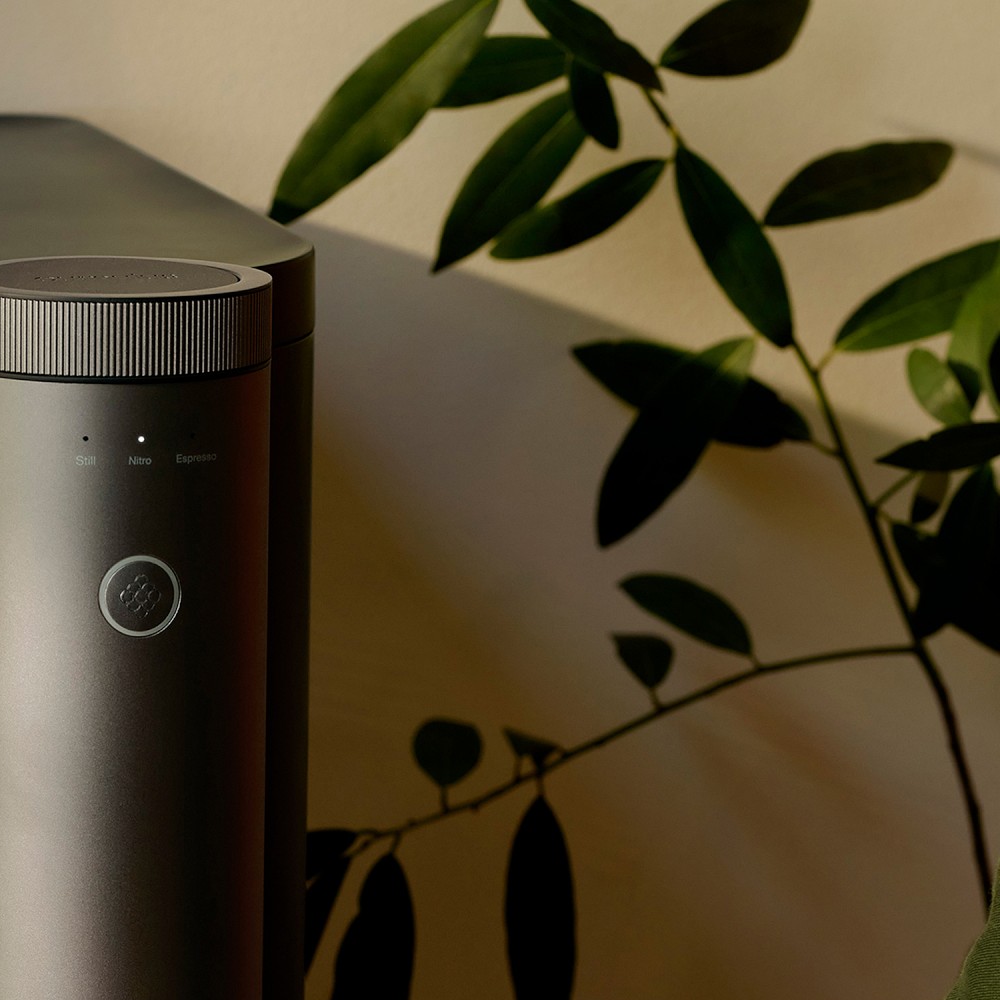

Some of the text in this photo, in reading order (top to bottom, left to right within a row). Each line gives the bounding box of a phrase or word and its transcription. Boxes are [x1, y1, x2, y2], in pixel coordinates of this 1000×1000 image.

[75, 455, 96, 466] Still
[128, 455, 152, 466] Nitro
[176, 453, 217, 464] Espresso
